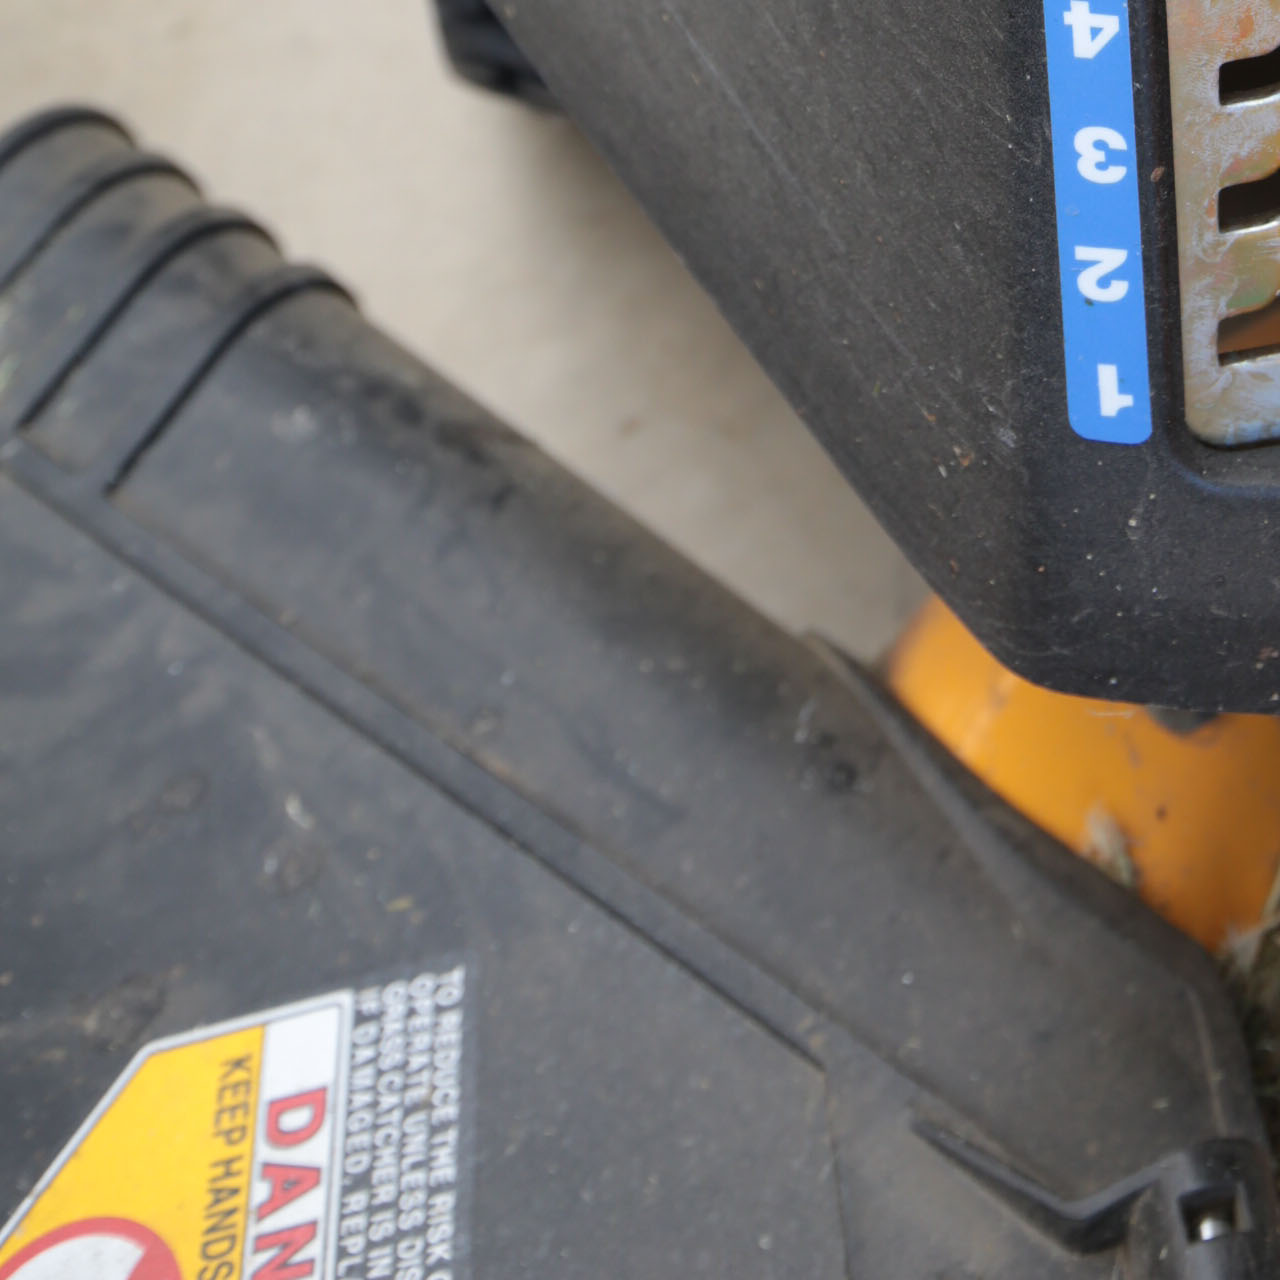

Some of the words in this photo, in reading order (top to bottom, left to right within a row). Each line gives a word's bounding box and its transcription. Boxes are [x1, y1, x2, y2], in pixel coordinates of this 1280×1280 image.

[1063, 0, 1120, 60] 4
[1073, 126, 1128, 185] 3
[1074, 245, 1129, 303] 2
[1097, 363, 1134, 417] 1
[356, 985, 381, 1016] IF
[434, 964, 466, 1008] TO
[378, 979, 409, 1072] GRASS
[403, 972, 438, 1108] OPERATE
[430, 1007, 464, 1127] REDUCE
[212, 1052, 252, 1147] KEEP
[370, 1069, 406, 1206] CATCHER
[397, 1108, 431, 1231] UNLESS
[428, 1124, 459, 1188] THE
[196, 1154, 245, 1280] HANDS
[367, 1207, 397, 1242] IS
[425, 1190, 456, 1267] RISK
[365, 1242, 394, 1279] IN
